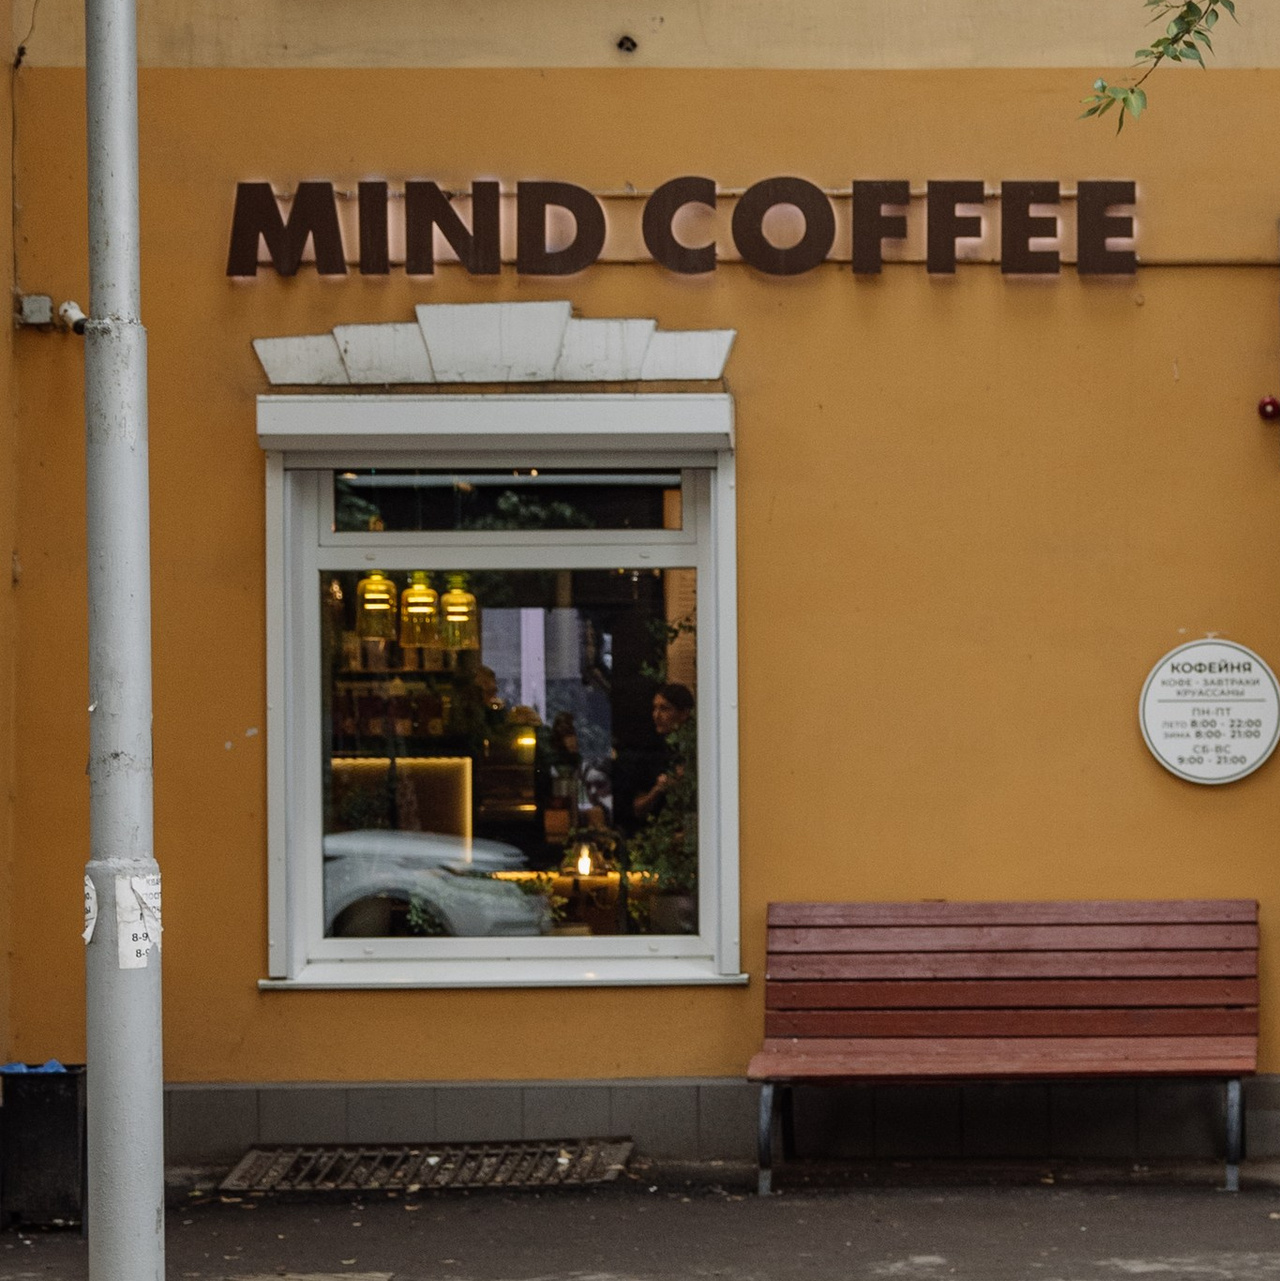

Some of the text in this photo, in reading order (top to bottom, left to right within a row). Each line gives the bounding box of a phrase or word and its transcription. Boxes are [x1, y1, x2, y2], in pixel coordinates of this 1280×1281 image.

[226, 175, 1137, 277] MIND COFFEE
[1170, 659, 1252, 674] КОФЕЙНЯ
[1161, 678, 1192, 686] КОФЕ
[1203, 678, 1260, 687] ЗАВТРАКИ
[1191, 707, 1232, 716] ПН-ПТ
[1190, 719, 1217, 728] 8:00
[1229, 719, 1262, 728] 22:00
